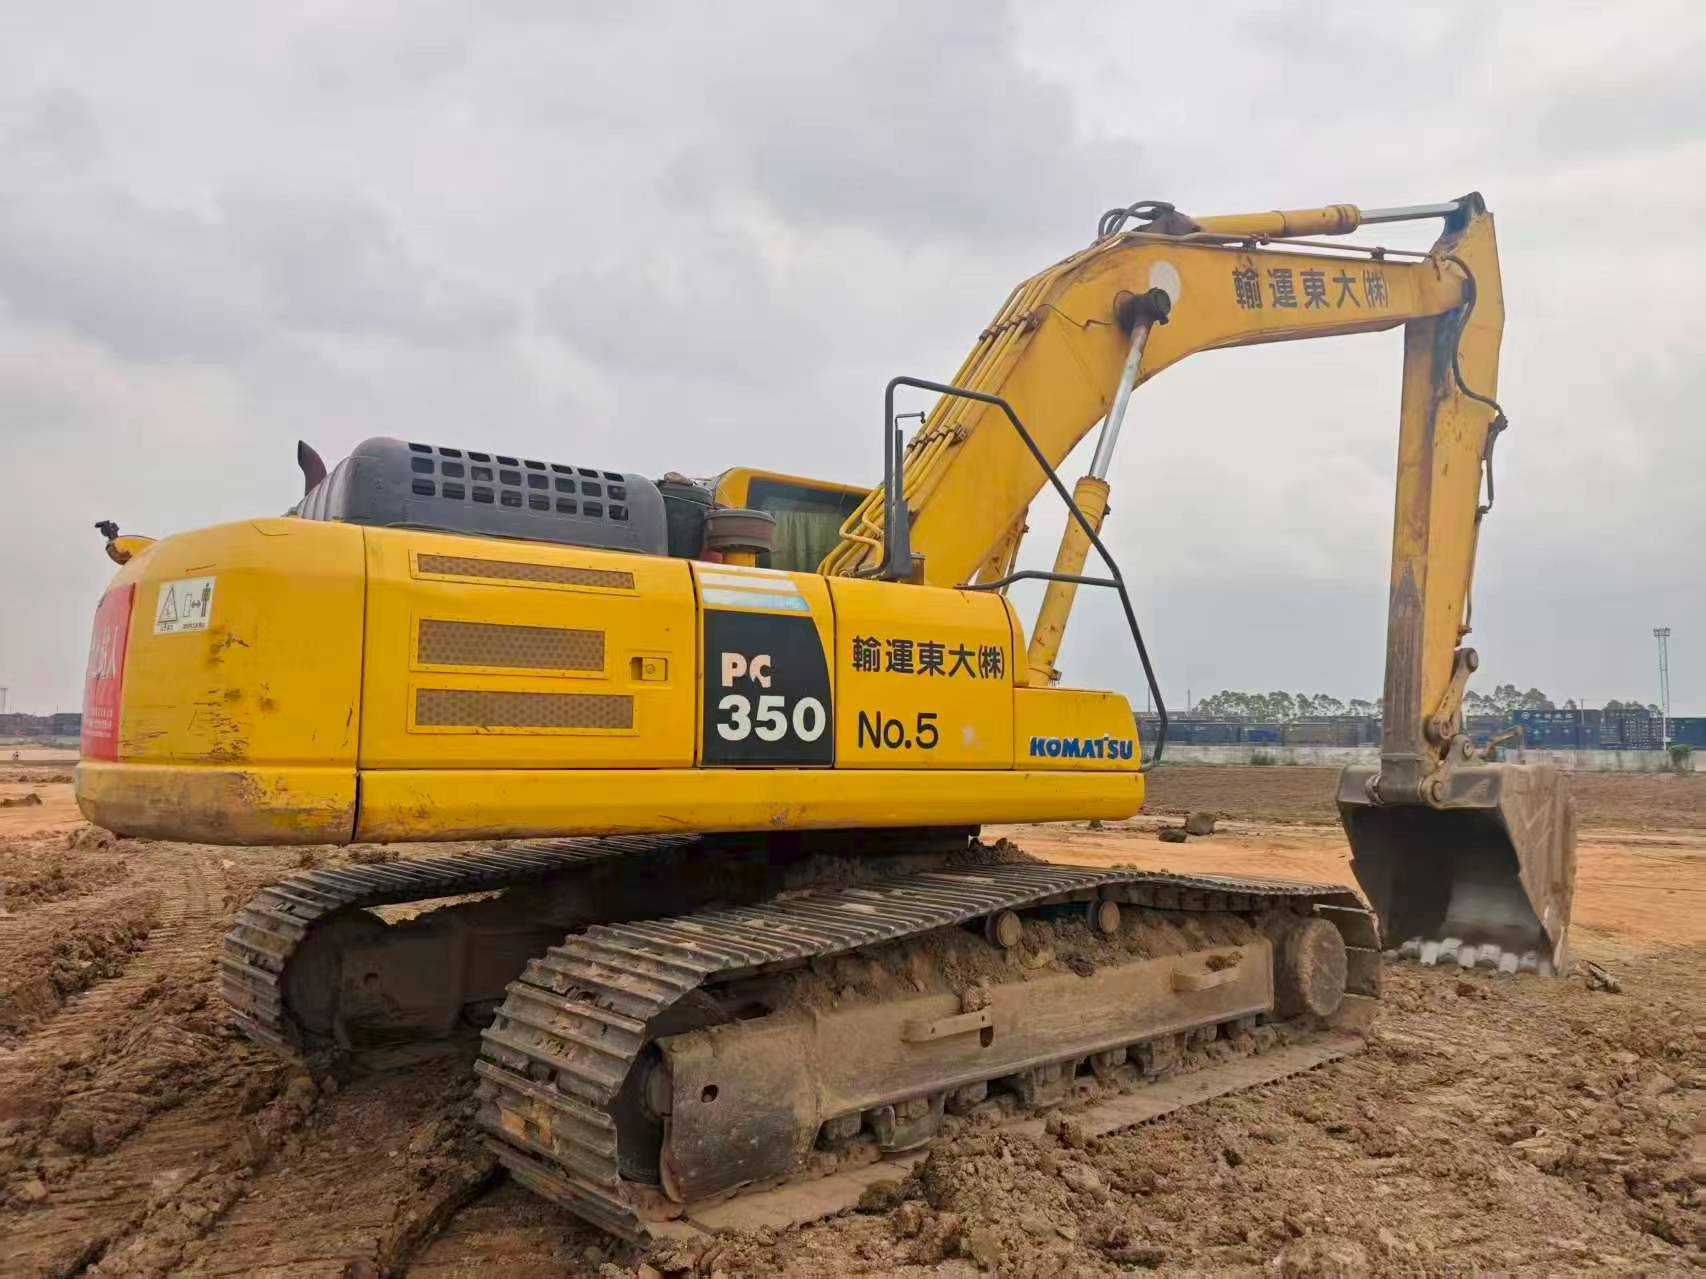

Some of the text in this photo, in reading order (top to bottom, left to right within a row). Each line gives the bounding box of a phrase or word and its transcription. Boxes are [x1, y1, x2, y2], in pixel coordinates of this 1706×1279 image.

[721, 652, 772, 689] PC
[717, 695, 826, 742] 350
[858, 711, 938, 750] No.5
[1030, 735, 1133, 760] KOMATSU
